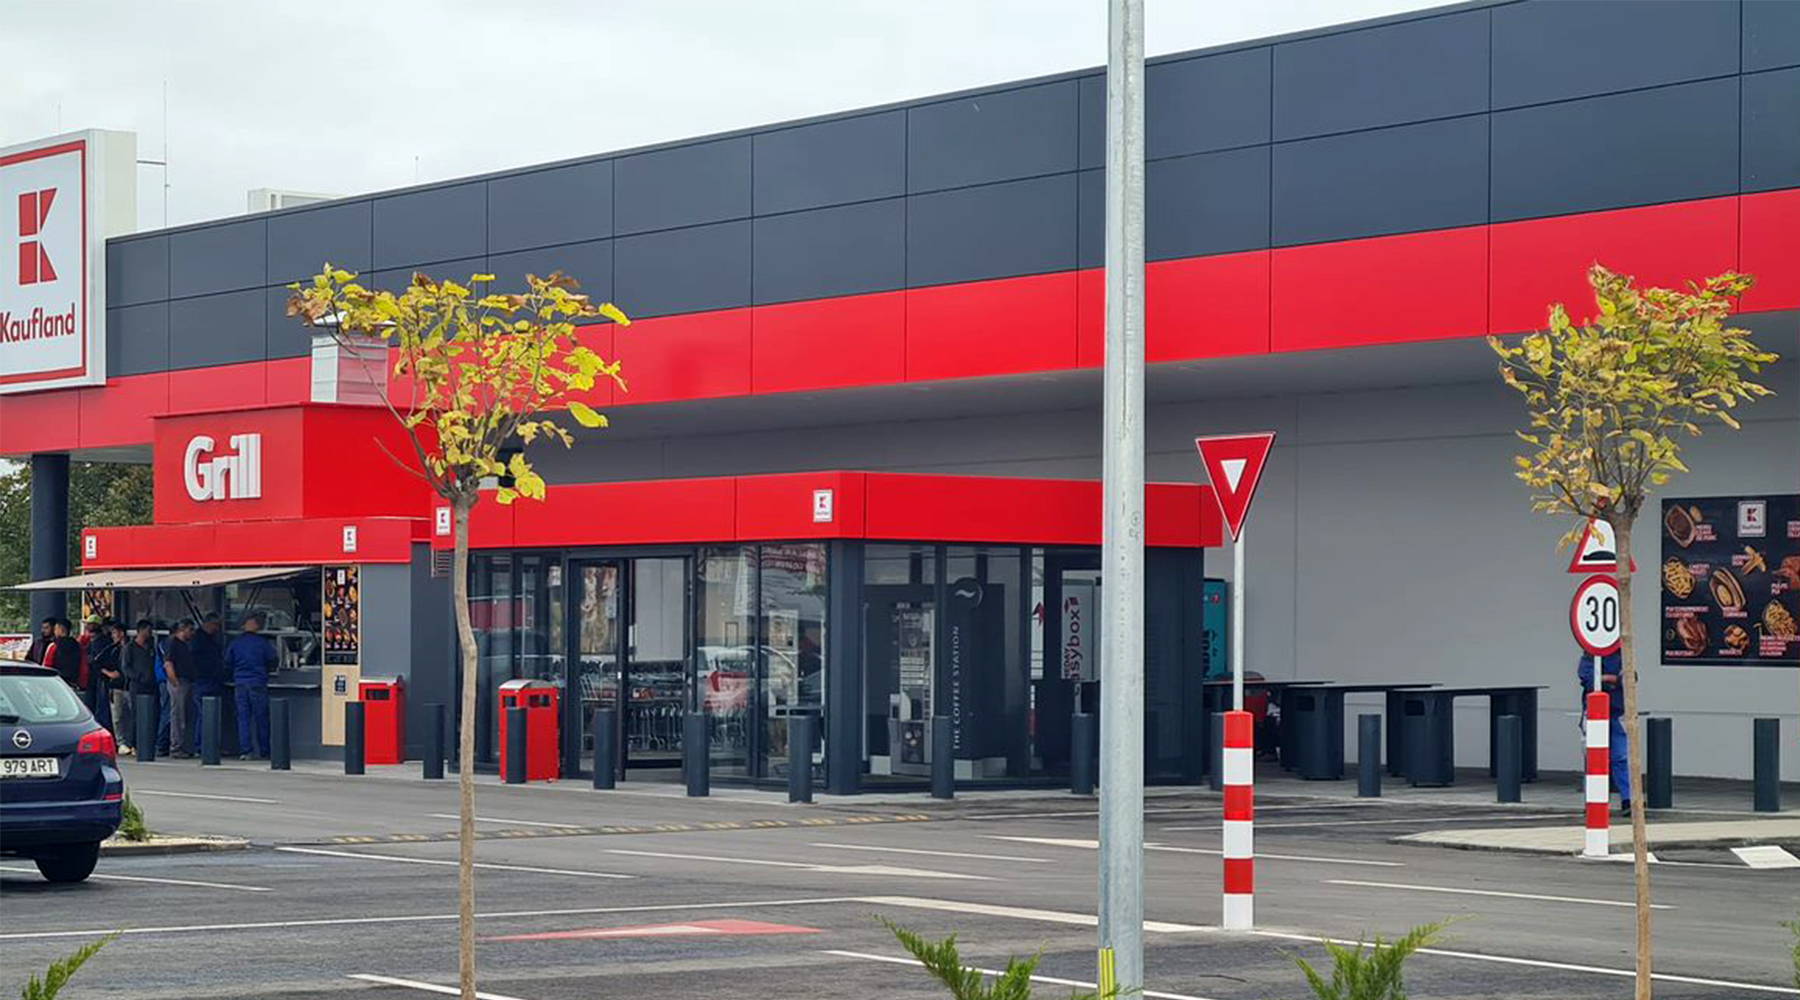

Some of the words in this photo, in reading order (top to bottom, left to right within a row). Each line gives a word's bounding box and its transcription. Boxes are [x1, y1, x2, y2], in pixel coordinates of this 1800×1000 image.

[0, 302, 75, 343] Kaufland
[184, 433, 261, 501] Grill
[1586, 596, 1616, 632] 30
[952, 626, 960, 676] STATION
[952, 681, 960, 725] COFFEE
[952, 729, 960, 750] THE
[4, 760, 27, 773] 979
[31, 760, 53, 772] ART
